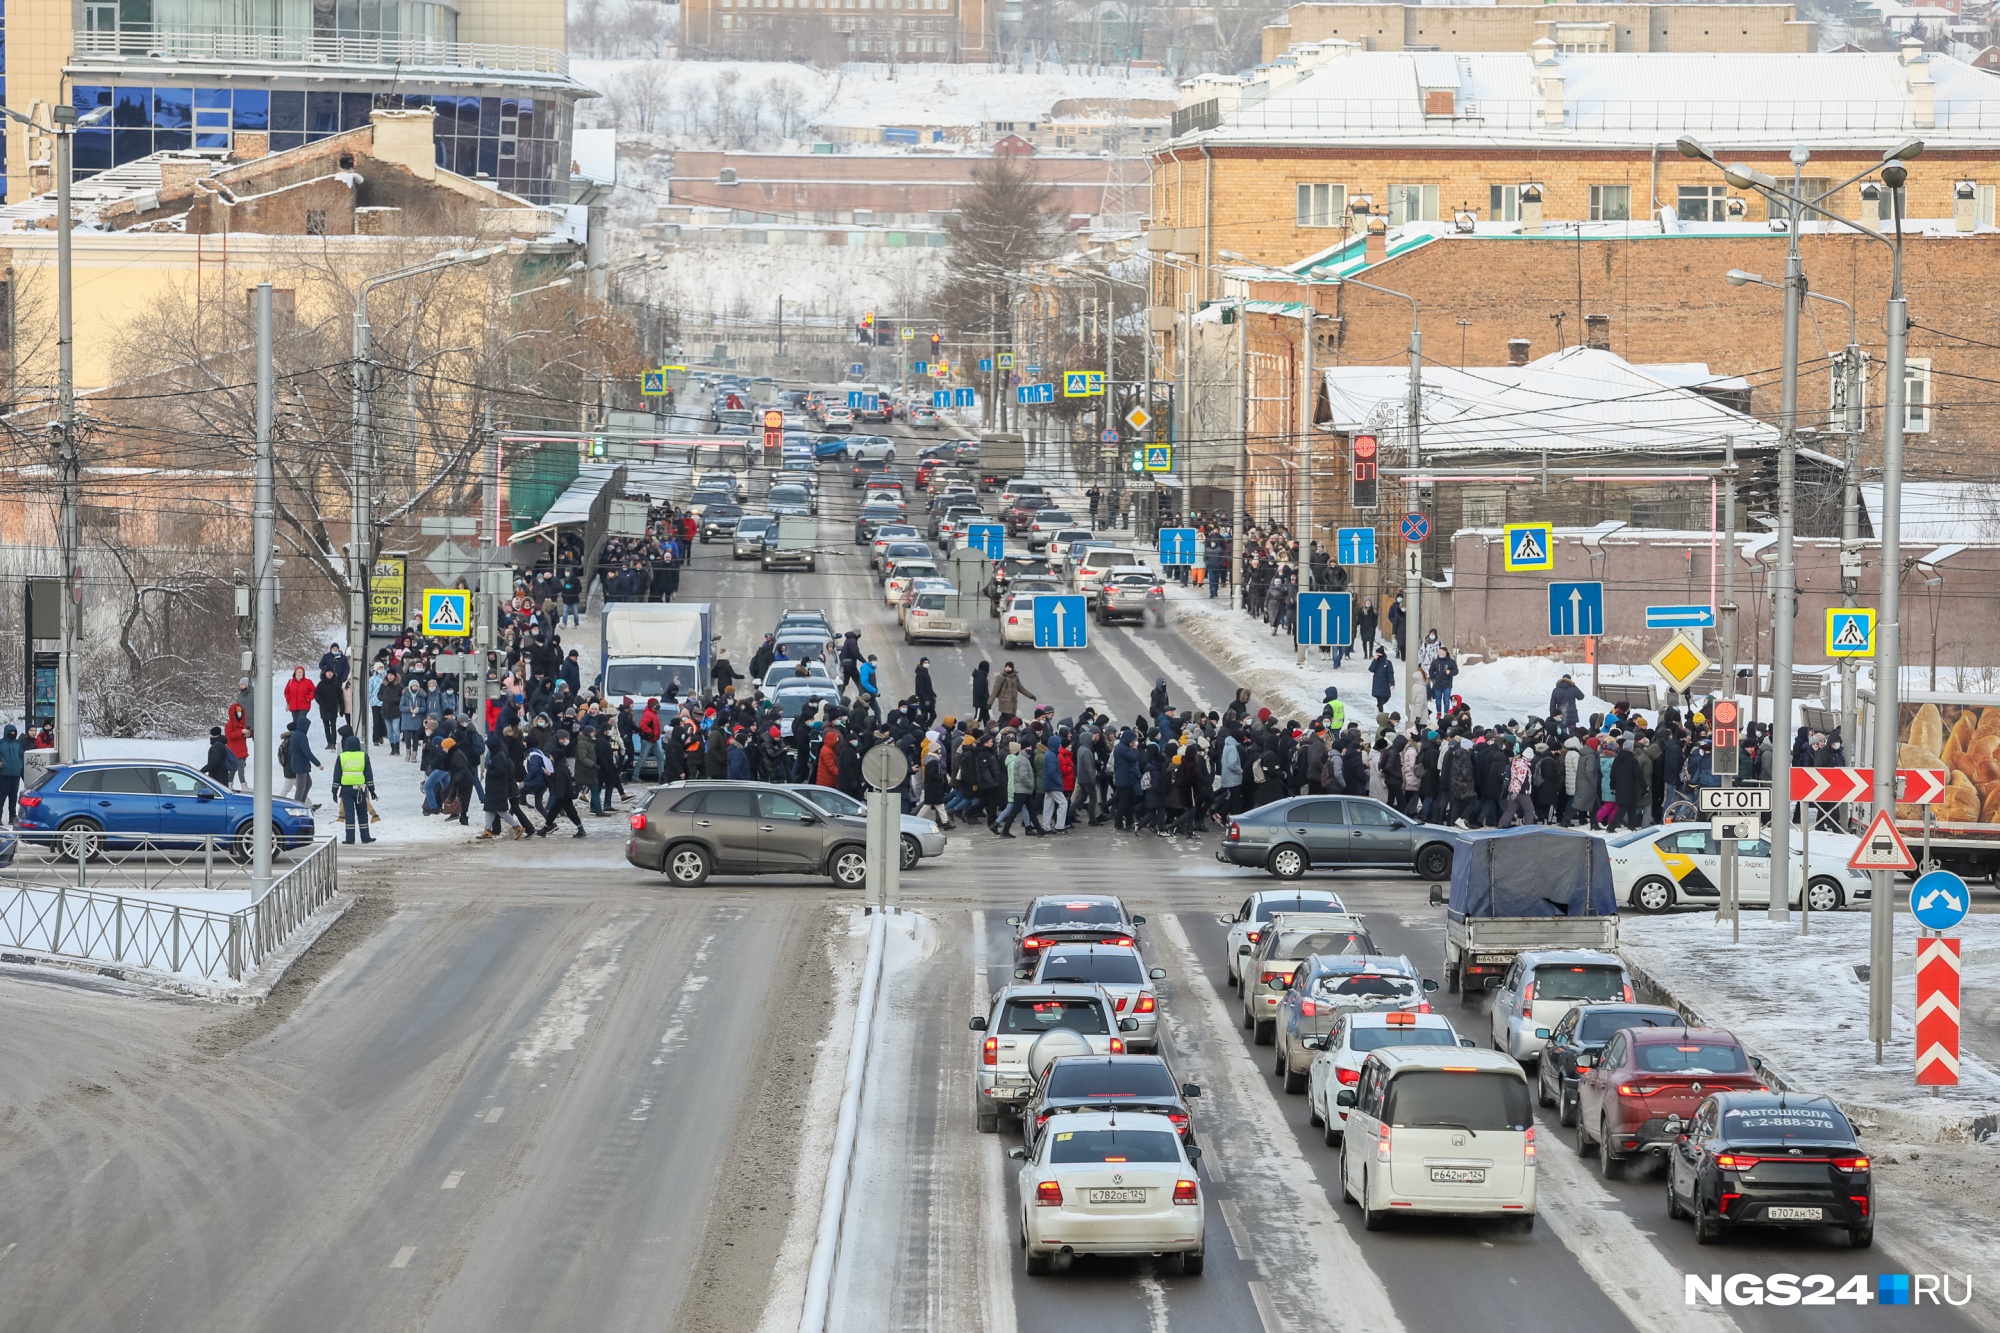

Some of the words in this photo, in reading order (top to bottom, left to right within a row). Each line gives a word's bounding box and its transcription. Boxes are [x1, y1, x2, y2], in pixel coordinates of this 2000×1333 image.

[765, 432, 781, 447] 07
[1355, 462, 1375, 481] 07
[1715, 728, 1736, 747] 07
[1710, 791, 1762, 807] СТОП
[1704, 859, 1717, 867] 696
[1744, 860, 1765, 869] Яндекс
[1740, 1108, 1832, 1120] АВТОШКОЛА
[1759, 1118, 1834, 1129] 2-888-376
